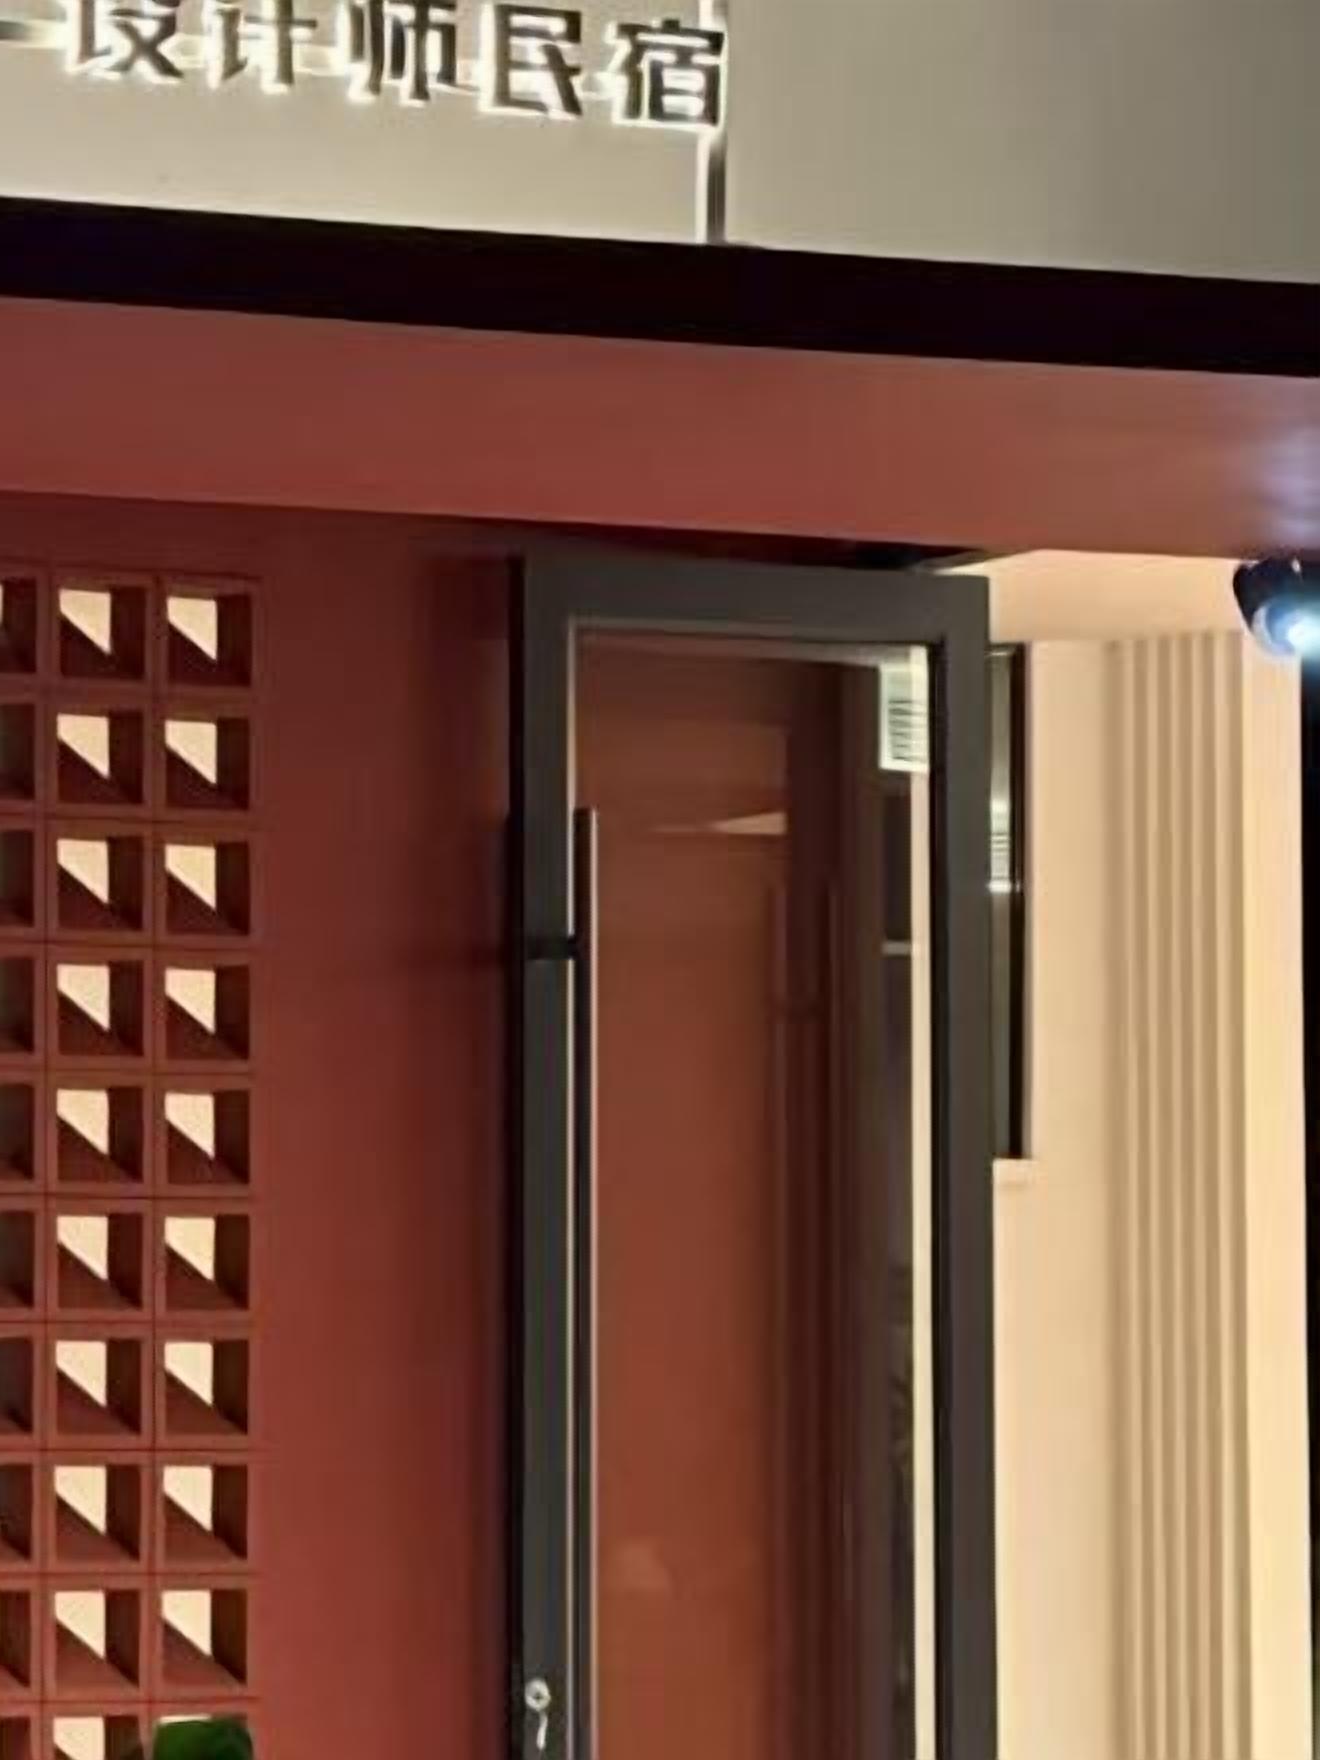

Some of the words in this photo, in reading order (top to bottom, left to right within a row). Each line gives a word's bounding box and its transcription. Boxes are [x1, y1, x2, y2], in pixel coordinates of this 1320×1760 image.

[70, 0, 726, 125] 设计师民宿
